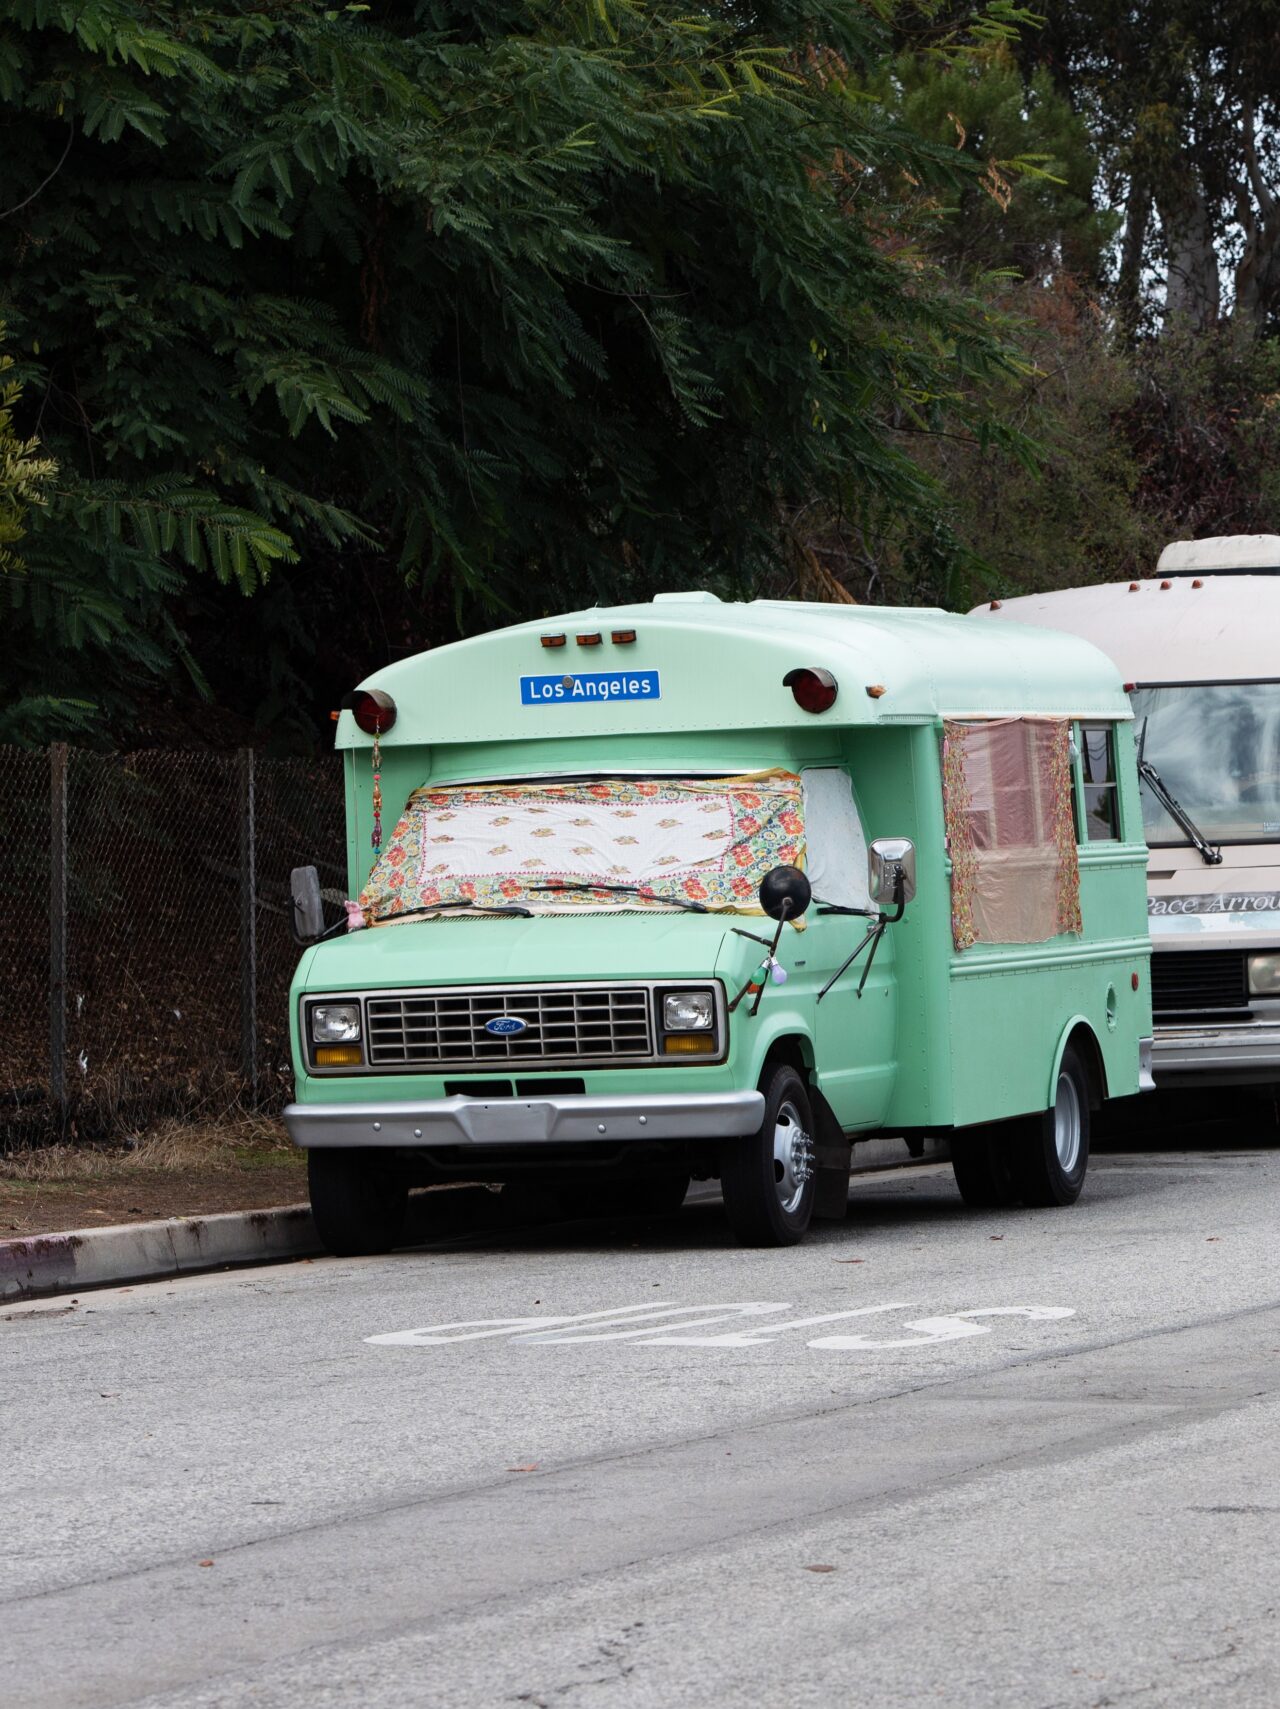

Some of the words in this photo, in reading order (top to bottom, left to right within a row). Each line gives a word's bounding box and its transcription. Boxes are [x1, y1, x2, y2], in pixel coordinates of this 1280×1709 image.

[530, 682, 564, 698] Los
[572, 677, 651, 700] Angeles
[494, 1020, 516, 1031] Ford
[363, 1302, 1075, 1348] STOP
